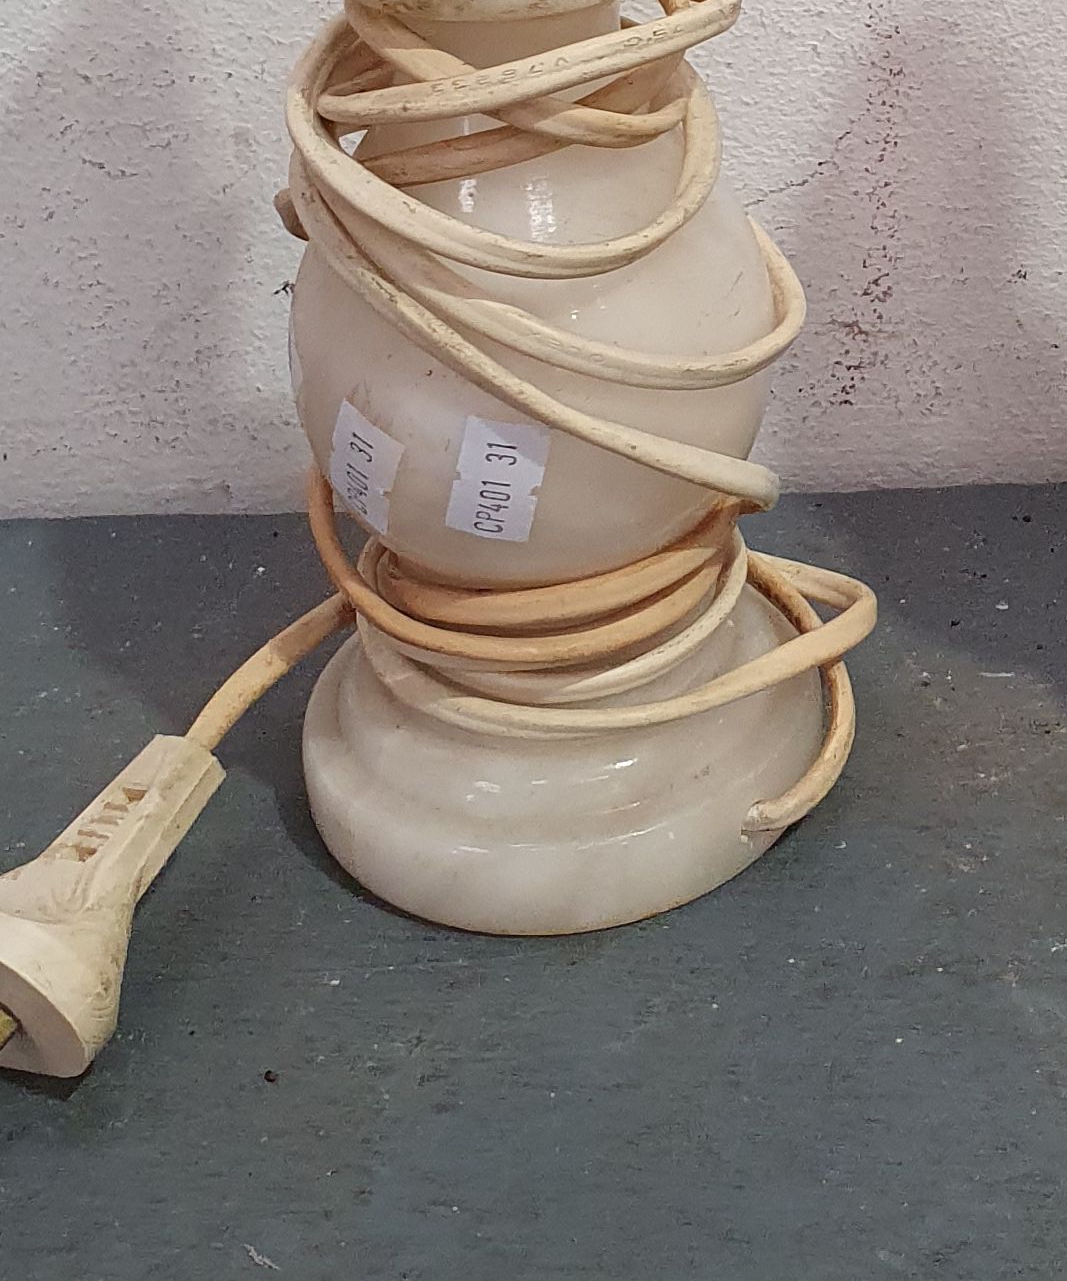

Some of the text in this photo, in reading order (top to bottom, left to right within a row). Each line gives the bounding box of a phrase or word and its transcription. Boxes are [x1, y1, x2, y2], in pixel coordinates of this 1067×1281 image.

[349, 431, 375, 463] 31
[473, 441, 518, 534] CP401 31
